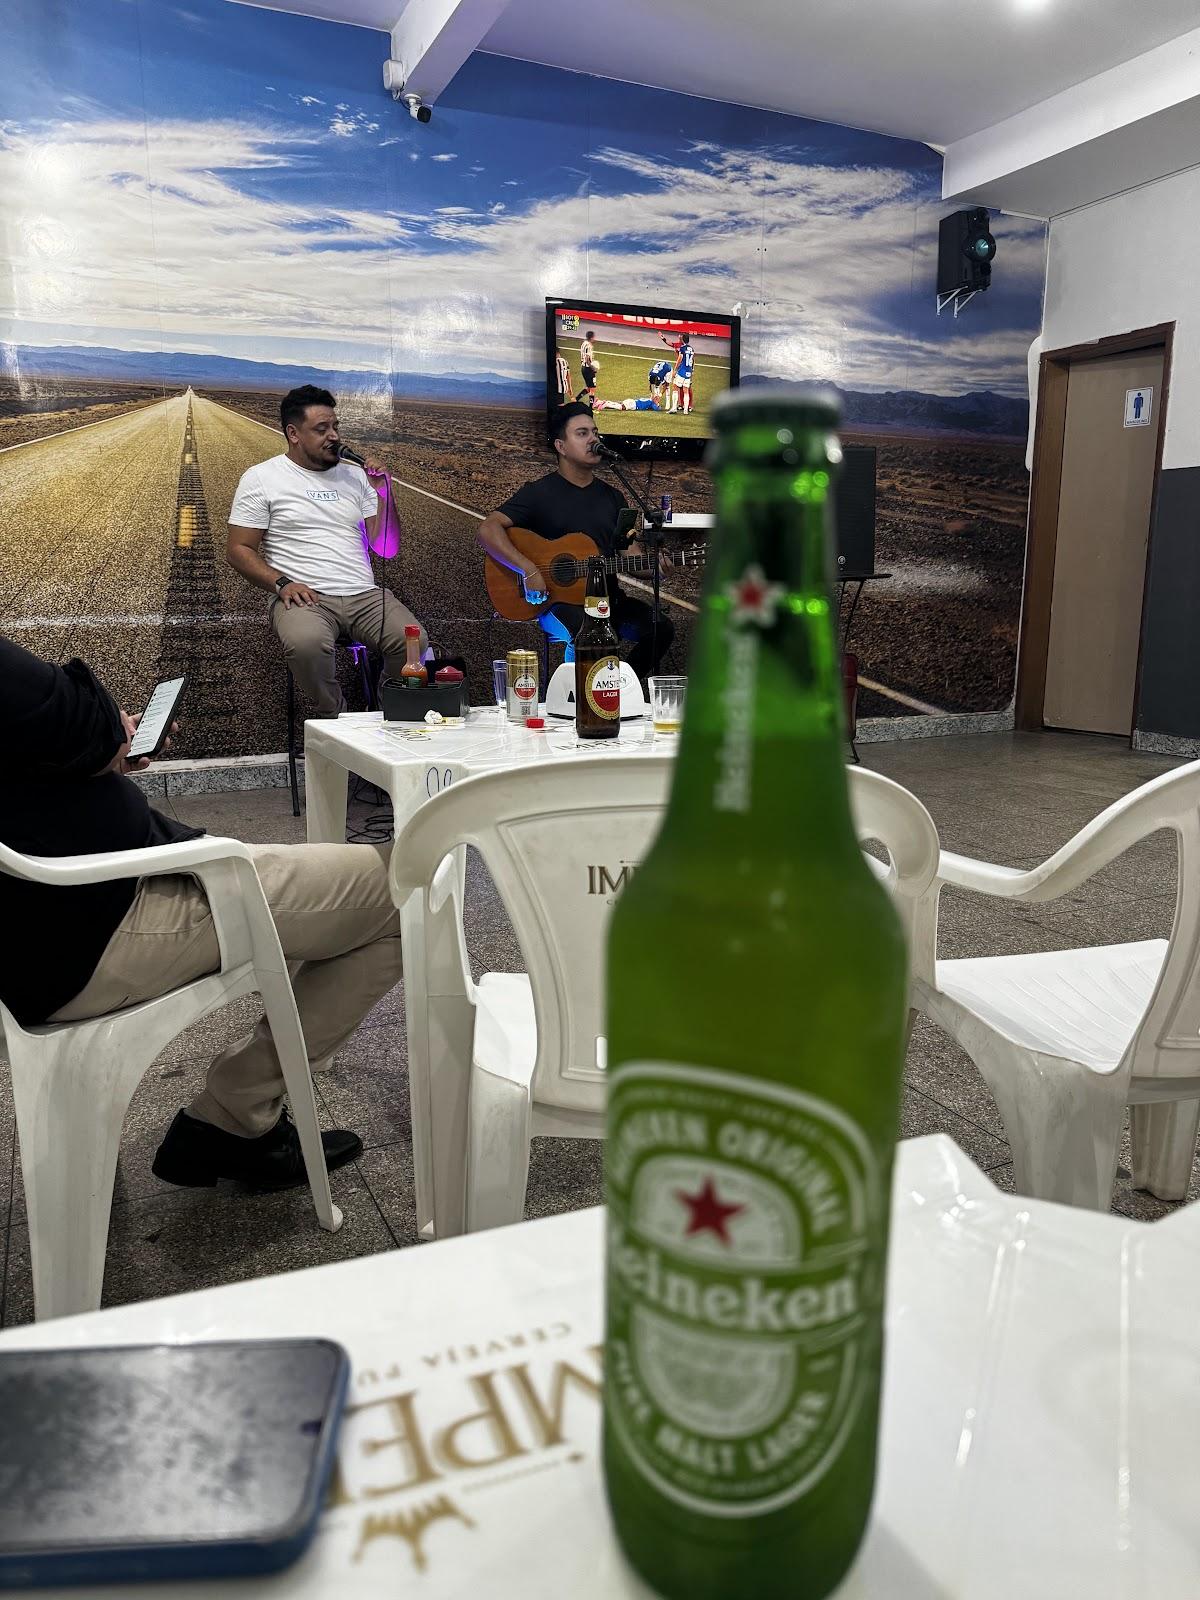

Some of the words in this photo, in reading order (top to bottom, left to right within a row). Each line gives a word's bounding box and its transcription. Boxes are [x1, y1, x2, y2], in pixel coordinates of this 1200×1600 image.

[596, 680, 620, 688] AMSTE
[587, 864, 641, 895] IM
[421, 1320, 573, 1369] CERVEJA
[356, 1363, 403, 1388] PU
[335, 1343, 605, 1504] MPE
